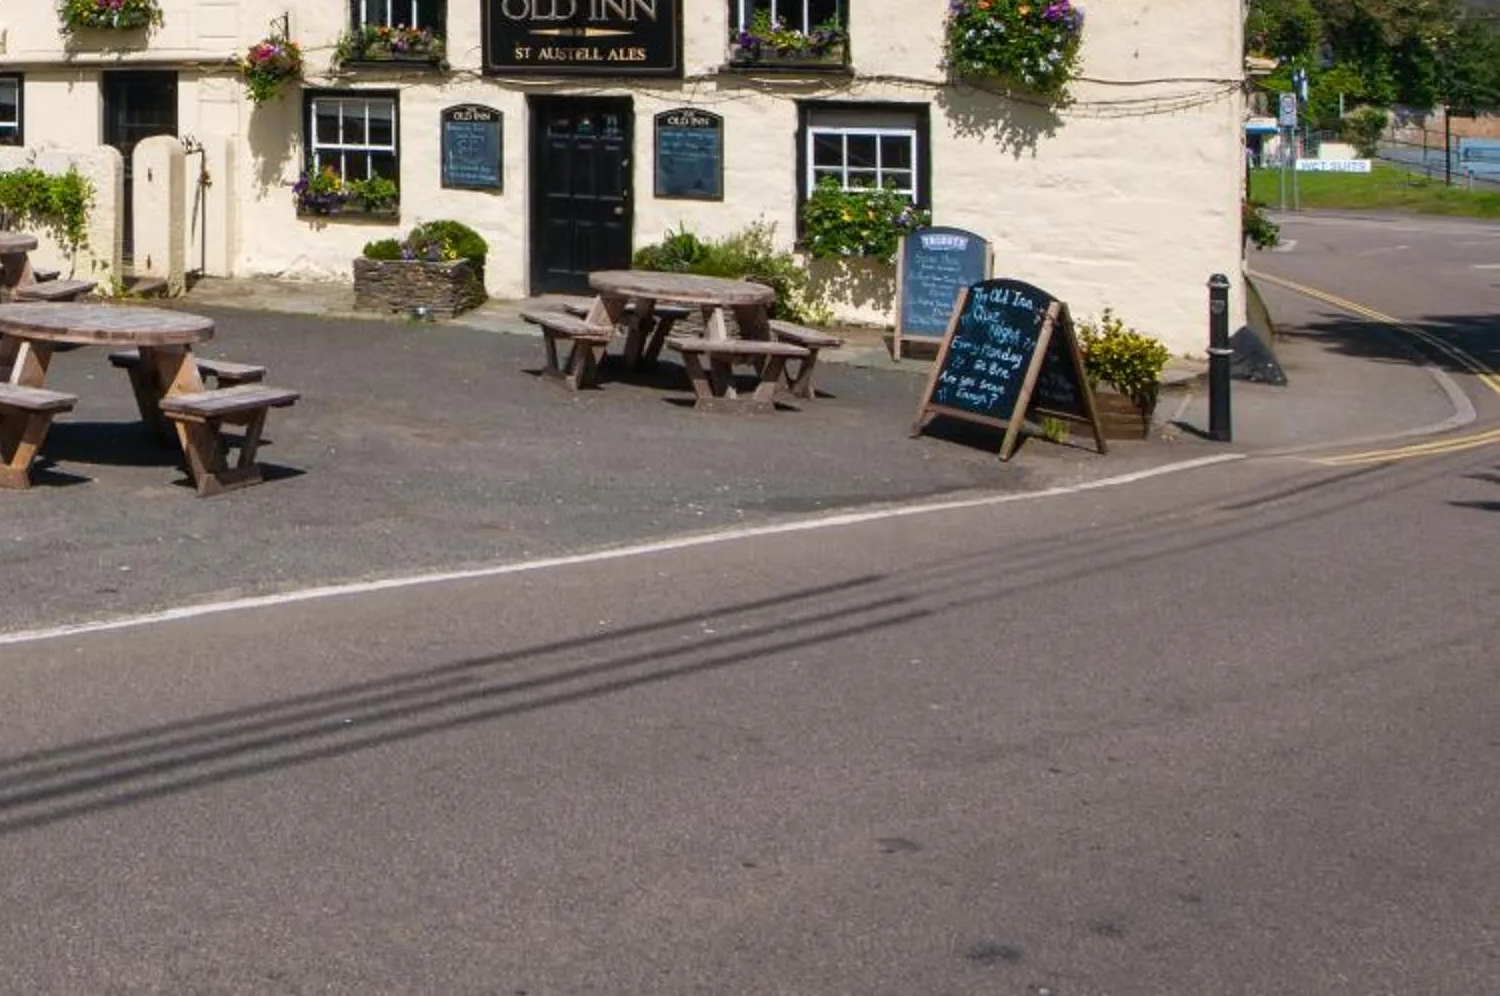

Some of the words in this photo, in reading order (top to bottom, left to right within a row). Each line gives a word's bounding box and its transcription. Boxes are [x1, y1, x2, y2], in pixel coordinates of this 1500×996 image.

[515, 47, 531, 60] ST
[538, 47, 604, 61] AUSTELL
[607, 47, 647, 62] ALES
